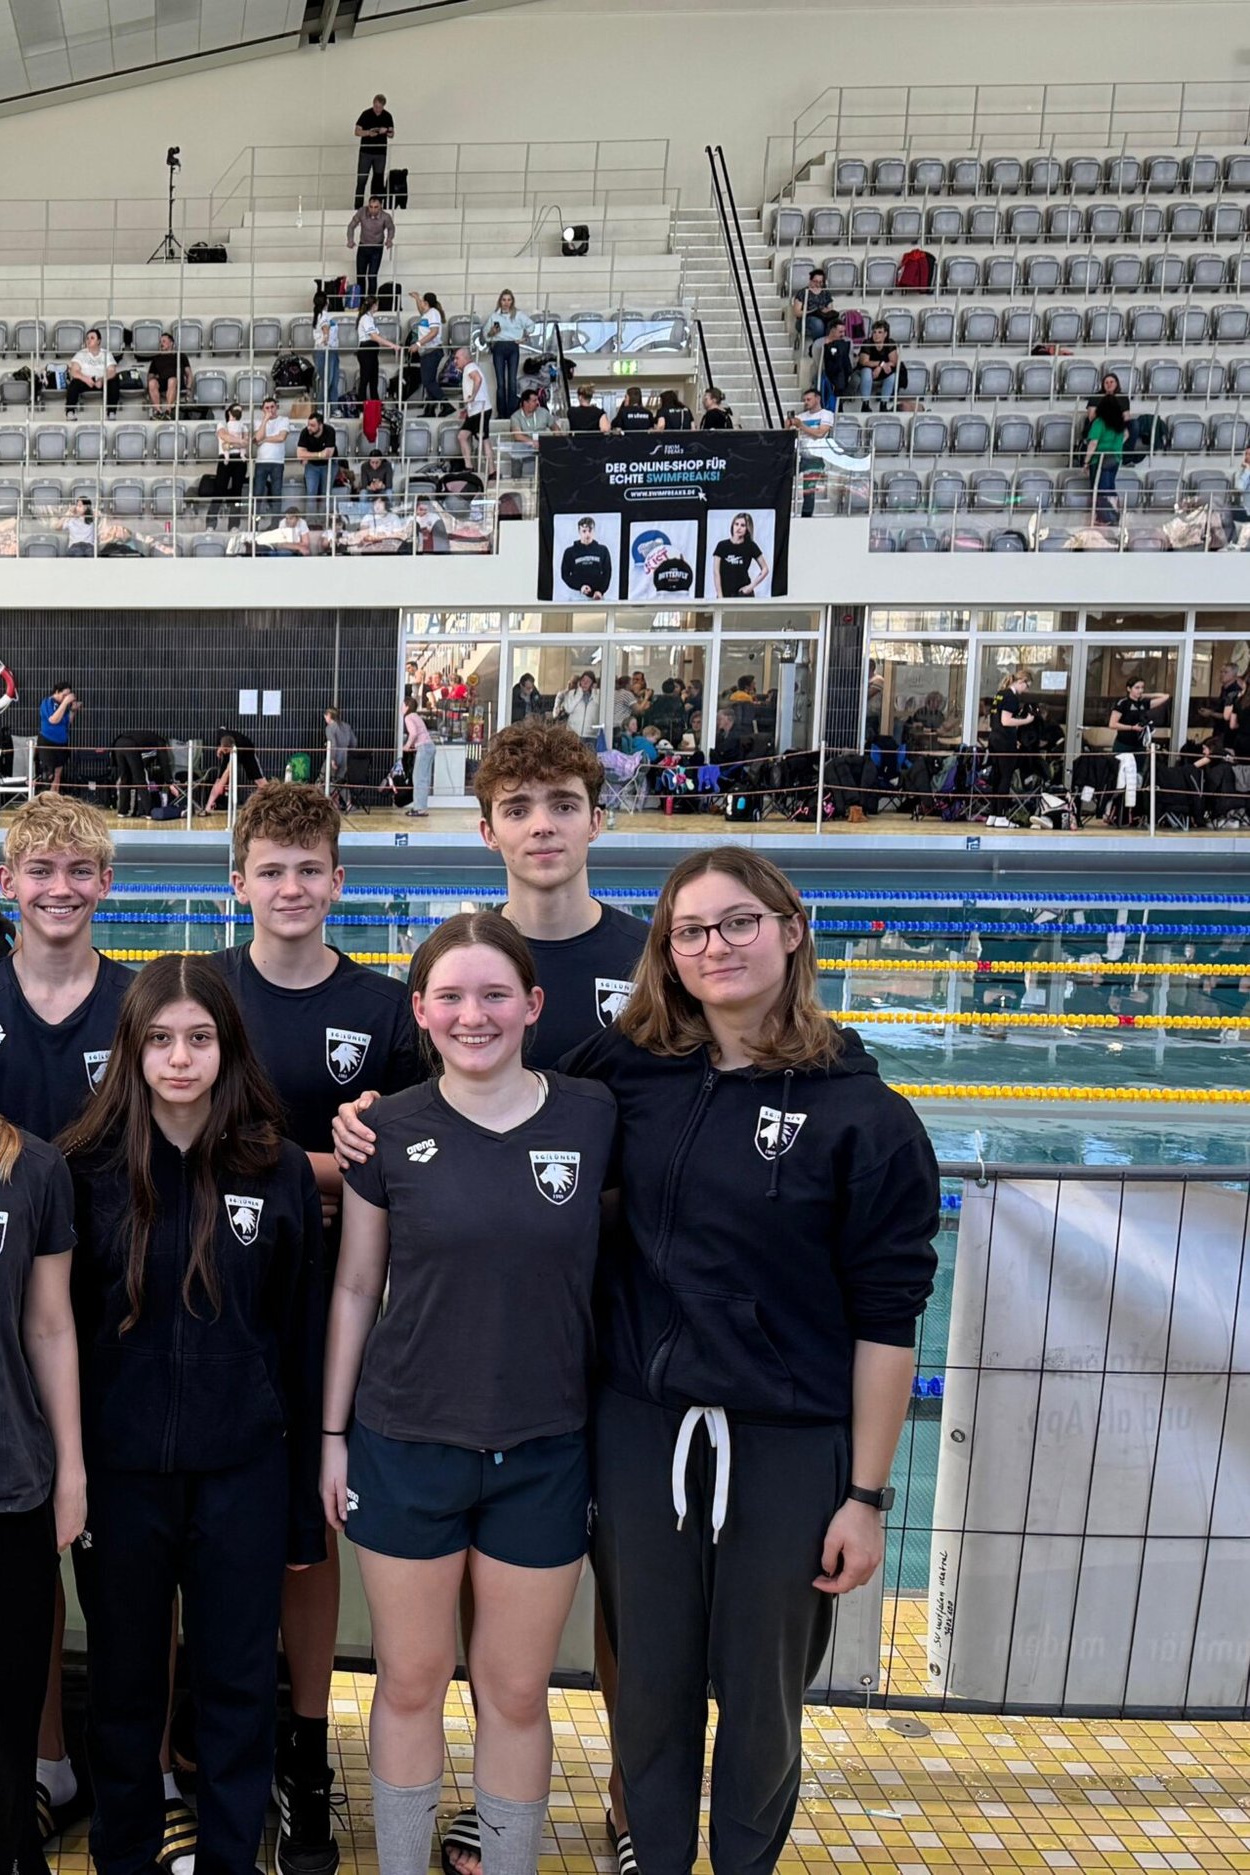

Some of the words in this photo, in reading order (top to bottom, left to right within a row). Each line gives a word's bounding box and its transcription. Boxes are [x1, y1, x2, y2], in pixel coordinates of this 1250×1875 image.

[605, 462, 627, 473] DER
[629, 459, 703, 472] ONLINE-SHOP
[706, 456, 727, 470] FÜR
[609, 473, 644, 485] ECHTE
[646, 470, 720, 483] SWIMFREAKS!
[630, 489, 696, 498] WWW.SWIMFREAKS.DE
[613, 982, 630, 991] LÜN
[406, 1138, 436, 1156] arena
